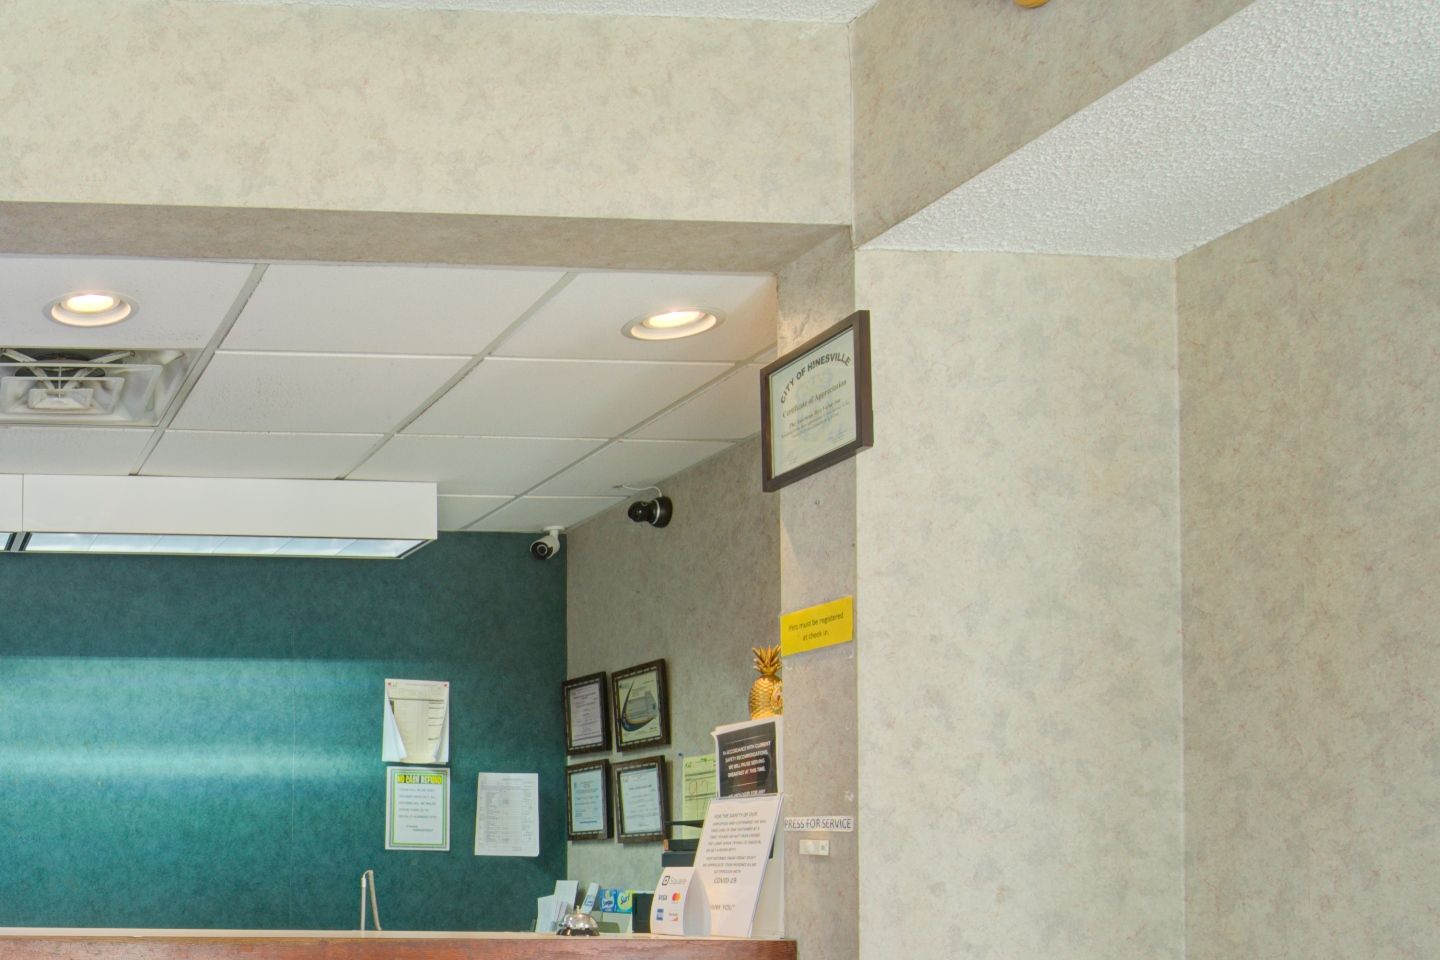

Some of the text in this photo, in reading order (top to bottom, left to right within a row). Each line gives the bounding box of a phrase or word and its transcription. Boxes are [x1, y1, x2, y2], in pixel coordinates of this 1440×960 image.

[780, 352, 852, 404] CITY OF HINESVILLE
[799, 620, 811, 630] must
[819, 611, 844, 625] registered
[808, 630, 822, 640] check
[405, 774, 420, 785] CASH
[420, 775, 442, 785] REFUND
[784, 818, 852, 829] PRESS FOR SERVICE
